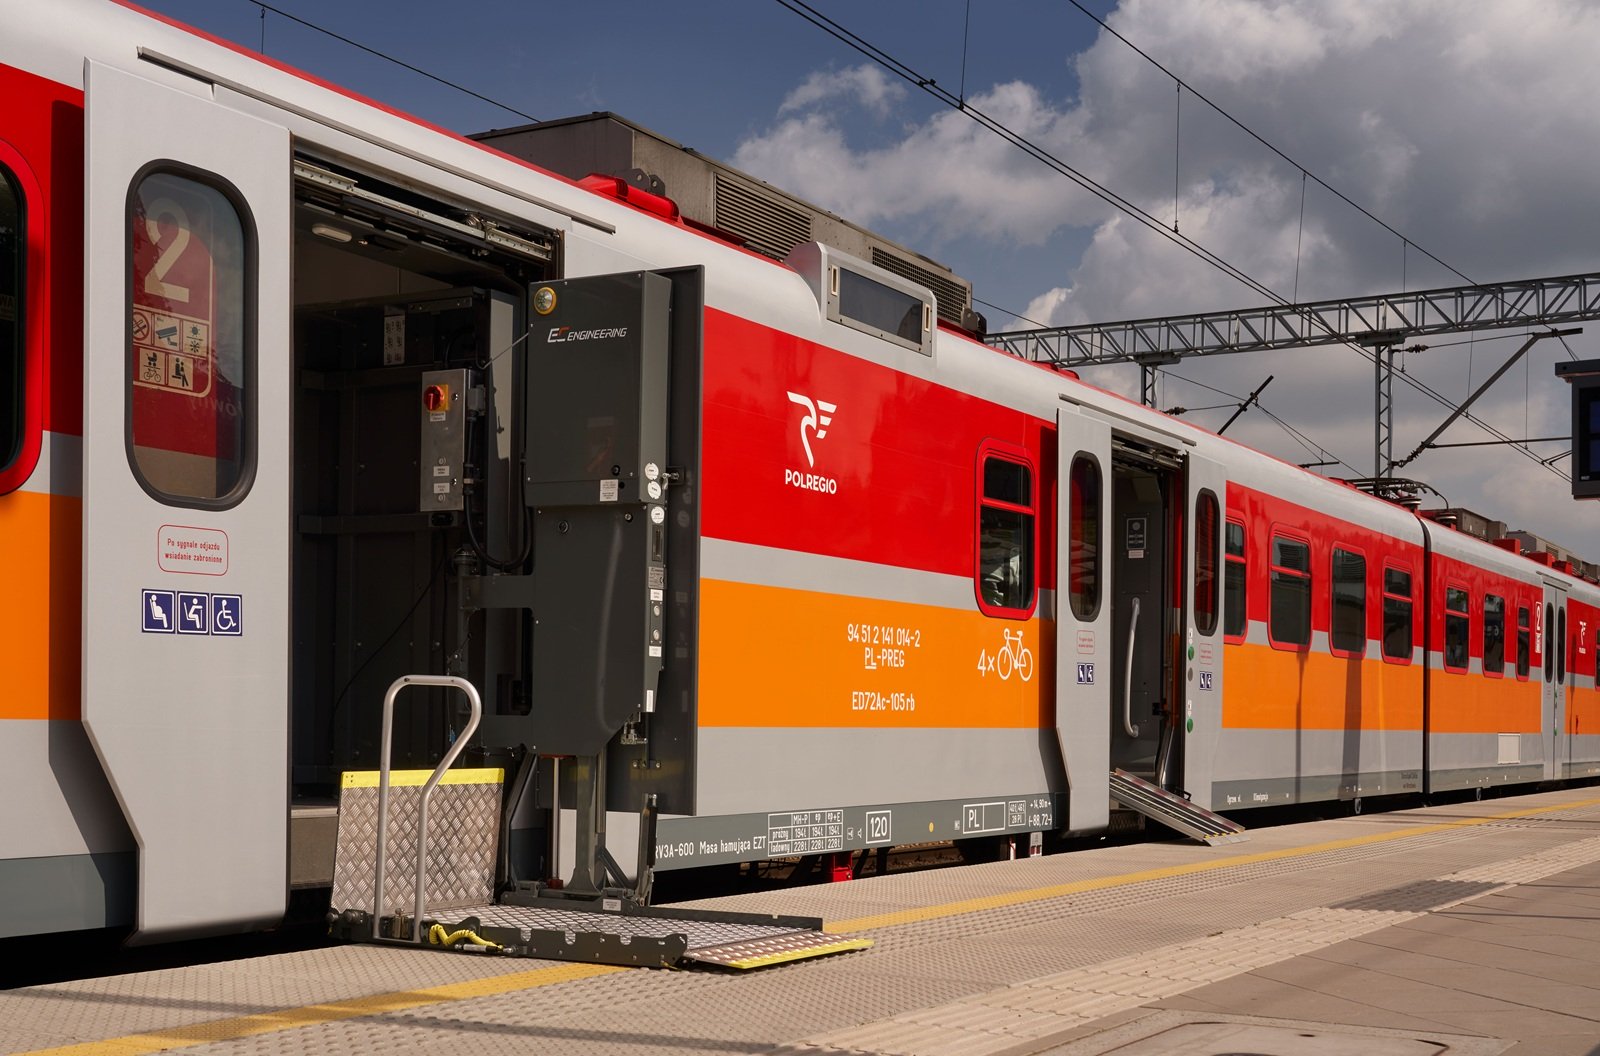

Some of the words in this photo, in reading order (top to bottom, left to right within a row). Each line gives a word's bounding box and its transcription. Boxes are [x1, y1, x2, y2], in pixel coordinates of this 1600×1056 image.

[144, 197, 191, 303] 2
[567, 327, 628, 342] ENGINEERING
[785, 468, 837, 495] POLREGIO
[167, 538, 175, 546] Po
[177, 541, 198, 549] sygnale
[200, 542, 220, 551] odjazdu
[165, 552, 192, 561] wsiadanie
[193, 554, 223, 563] zabronione
[847, 623, 860, 643] 94
[861, 624, 871, 644] 51
[873, 625, 879, 645] 2
[881, 626, 894, 645] 141
[896, 627, 921, 648] 014-2
[864, 647, 905, 669] PL-PREG
[977, 648, 995, 677] 4x
[870, 816, 888, 838] 120
[968, 809, 980, 829] PL
[699, 840, 718, 855] Masa
[720, 838, 751, 854] hamująca
[753, 836, 767, 850] EZT
